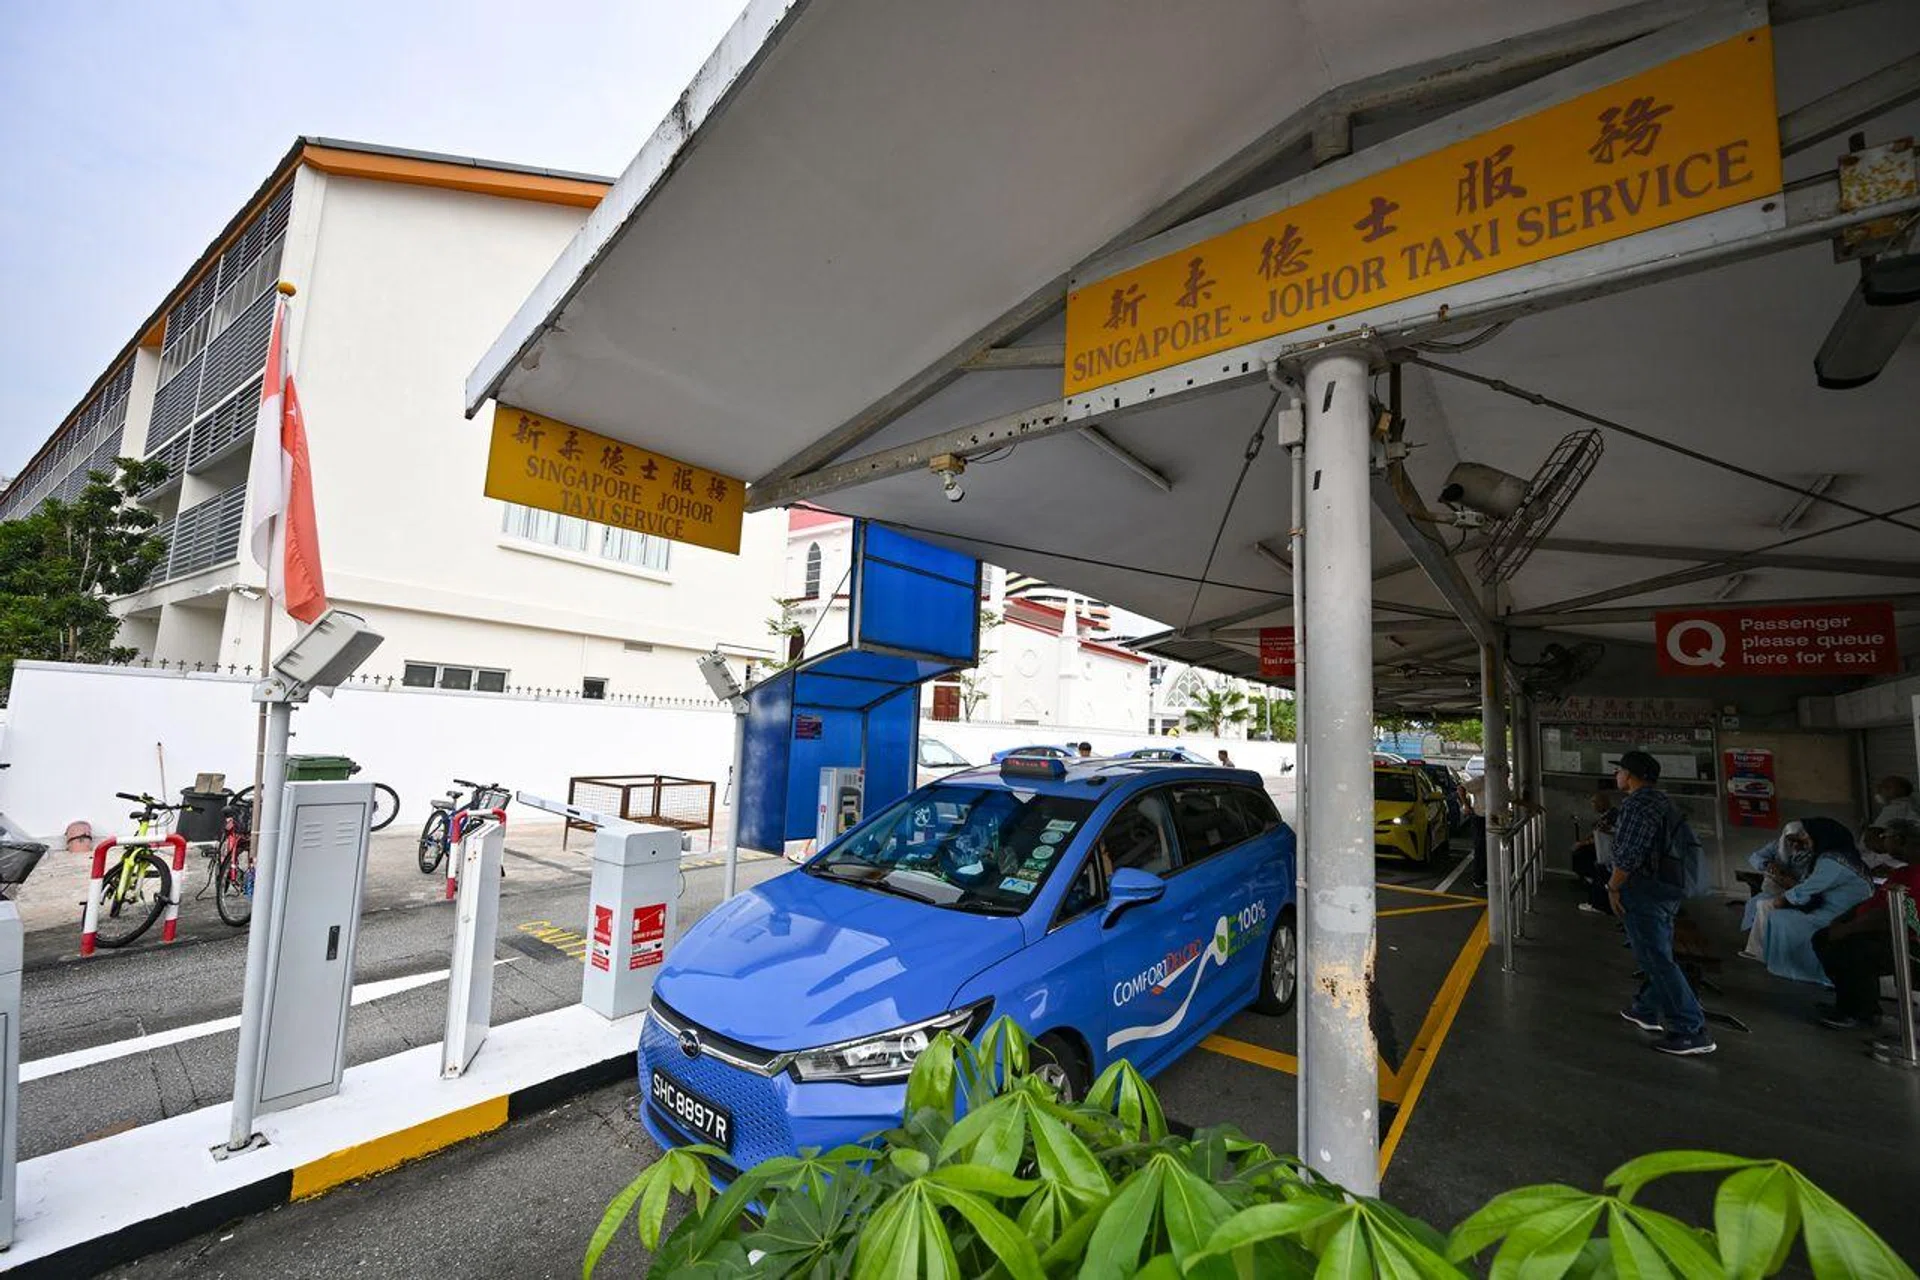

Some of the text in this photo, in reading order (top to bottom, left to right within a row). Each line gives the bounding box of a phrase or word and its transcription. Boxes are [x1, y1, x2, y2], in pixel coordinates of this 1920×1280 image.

[1071, 306, 1234, 383] SINGAPORE
[1261, 255, 1388, 325] JOHOR
[1400, 220, 1501, 281] TAXI
[1516, 139, 1755, 248] SERVICE
[526, 455, 713, 523] SINGAPORE JOHOR
[560, 488, 685, 539] TAXI SERVICE
[1666, 619, 1726, 668] Q
[1740, 616, 1851, 632] Passenger
[1742, 633, 1885, 650] please queue
[1264, 657, 1278, 665] Taxi
[1742, 650, 1876, 665] here for taxi
[1238, 898, 1266, 932] 100%
[653, 1073, 727, 1142] SHC8897R
